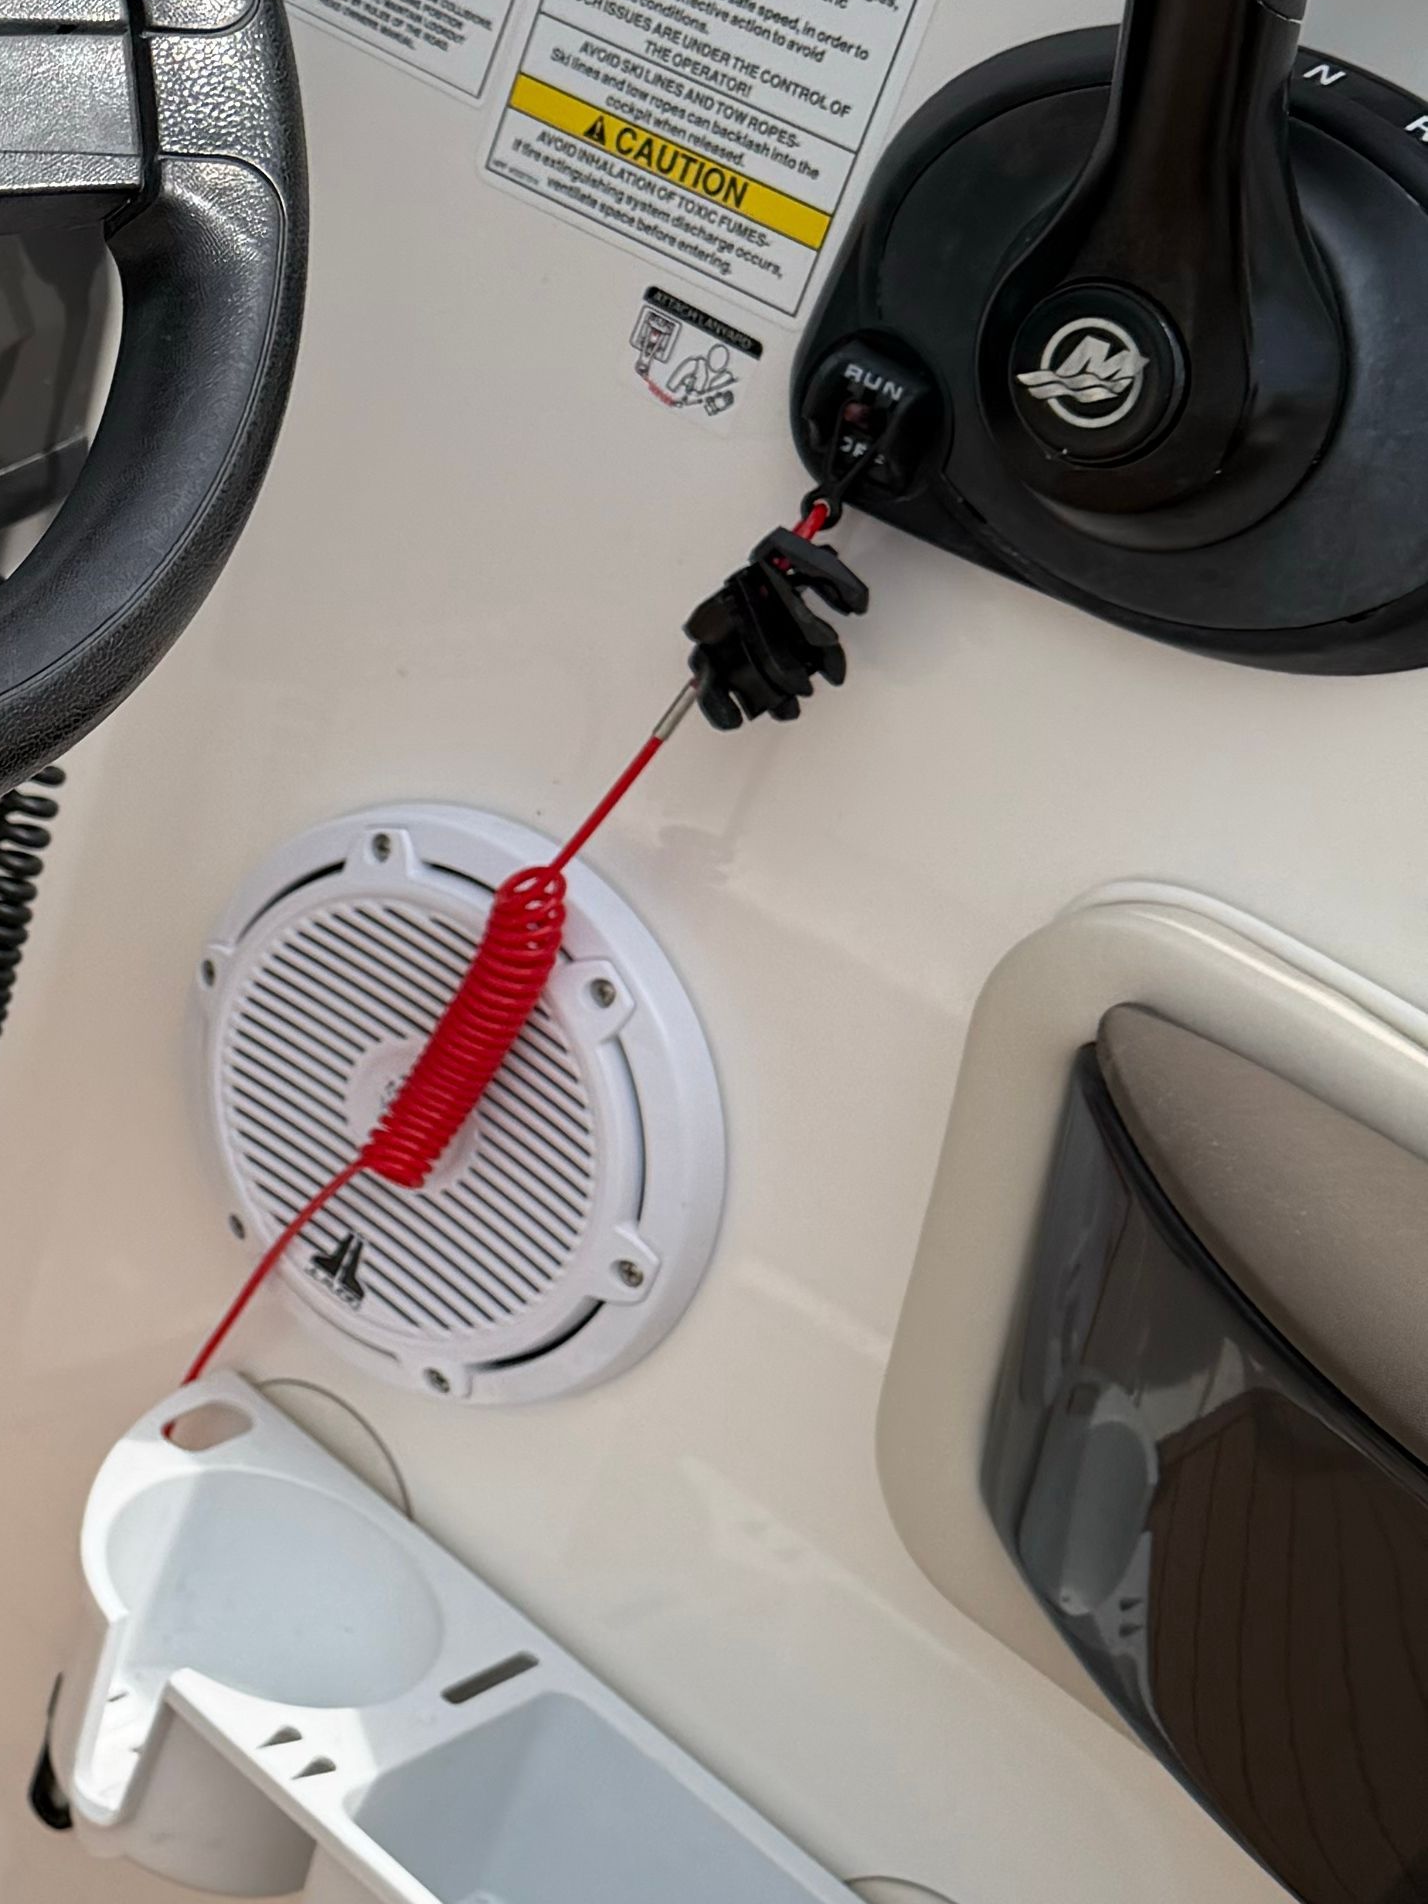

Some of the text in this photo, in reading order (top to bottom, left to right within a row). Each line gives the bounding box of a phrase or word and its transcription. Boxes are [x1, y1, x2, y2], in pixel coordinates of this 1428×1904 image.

[578, 40, 621, 68] AVOID
[620, 58, 644, 79] SKI
[643, 68, 684, 97] LINES
[683, 87, 715, 110] AND
[715, 100, 748, 125] TOW
[602, 0, 652, 31] ISSUES
[651, 22, 682, 45] ARE
[681, 33, 731, 66] UNDER
[732, 55, 760, 79] THE
[759, 68, 827, 110] CONTROL
[829, 99, 851, 117] OF
[644, 39, 752, 97] THE OPERATOR!
[1302, 64, 1347, 86] N
[550, 47, 819, 179] Ski lines and tow ropes can backlash into the
[605, 95, 744, 167] cockpit when released.
[535, 130, 577, 157] AVOID
[576, 147, 657, 195] INHALATION
[656, 185, 677, 202] OF
[677, 194, 718, 224] TOXIC
[615, 126, 748, 208] CAUTION
[844, 363, 904, 401] RUN
